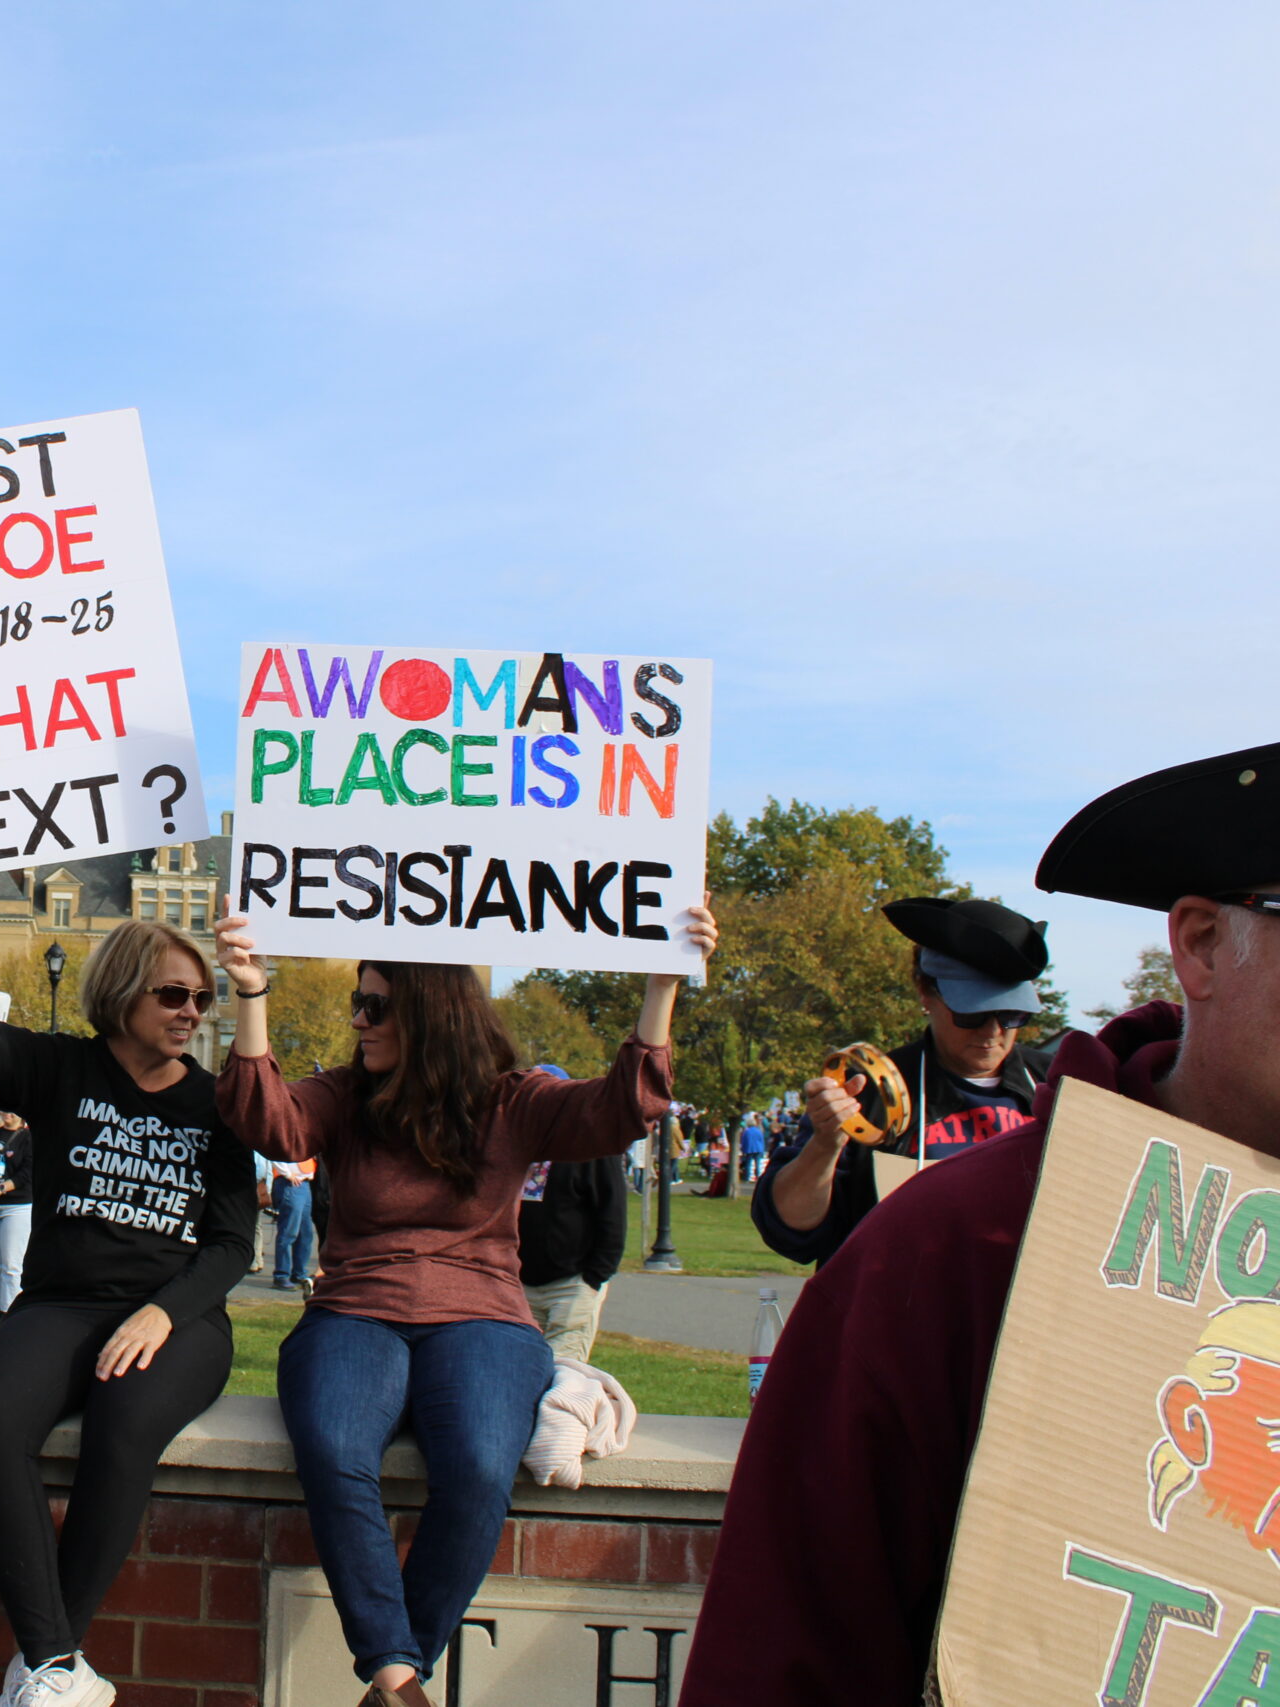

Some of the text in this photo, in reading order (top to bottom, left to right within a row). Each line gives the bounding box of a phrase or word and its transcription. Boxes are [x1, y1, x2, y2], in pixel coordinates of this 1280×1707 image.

[251, 728, 679, 818] PLACE IS IN
[239, 842, 673, 941] RESISTANCE
[93, 1126, 197, 1166] ARE NOT
[69, 1145, 206, 1198] CRIMINALS,
[89, 1175, 190, 1216] BUT THE
[56, 1193, 181, 1236] PRESIDENT
